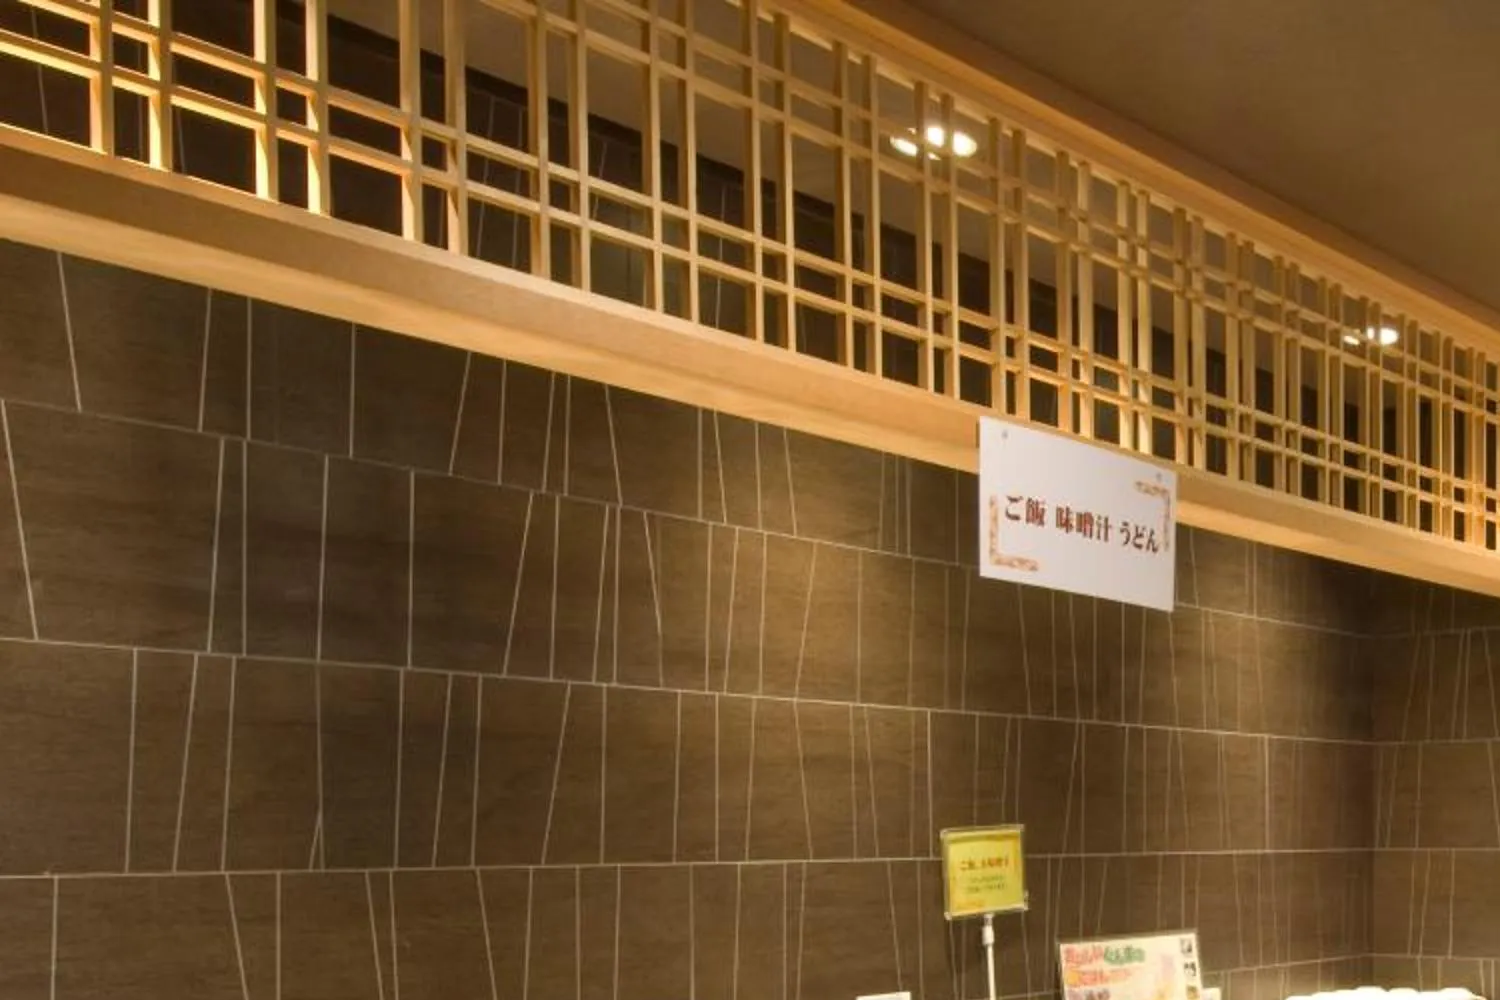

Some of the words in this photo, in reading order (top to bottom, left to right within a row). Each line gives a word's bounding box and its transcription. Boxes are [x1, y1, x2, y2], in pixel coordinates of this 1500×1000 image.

[1005, 496, 1046, 527] ご飯
[1055, 505, 1111, 543] 味噌汁
[1119, 521, 1159, 554] うどん
